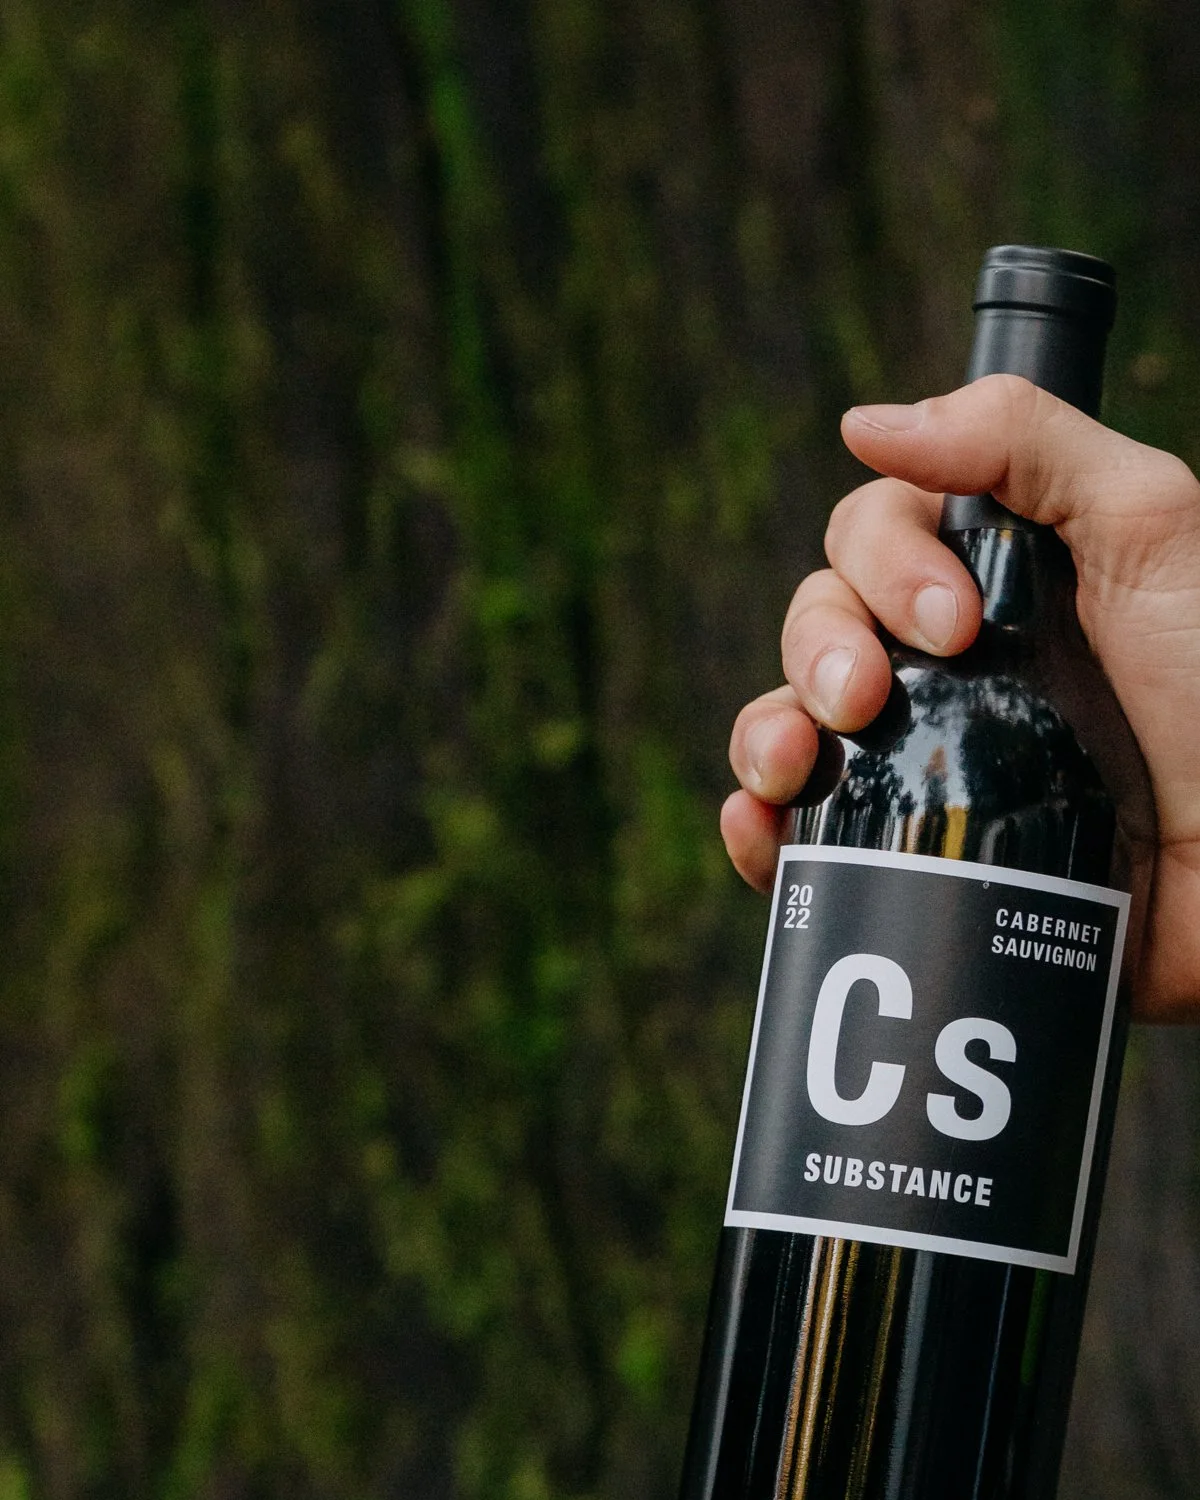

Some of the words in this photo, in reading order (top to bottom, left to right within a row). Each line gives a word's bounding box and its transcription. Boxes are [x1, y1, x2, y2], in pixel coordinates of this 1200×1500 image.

[787, 884, 813, 907] 20
[783, 907, 810, 929] 22
[995, 908, 1101, 945] CABERNET
[991, 935, 1097, 972] SAUVIGNON
[806, 953, 1017, 1141] Cs
[803, 1152, 993, 1207] SUBSTANCE
